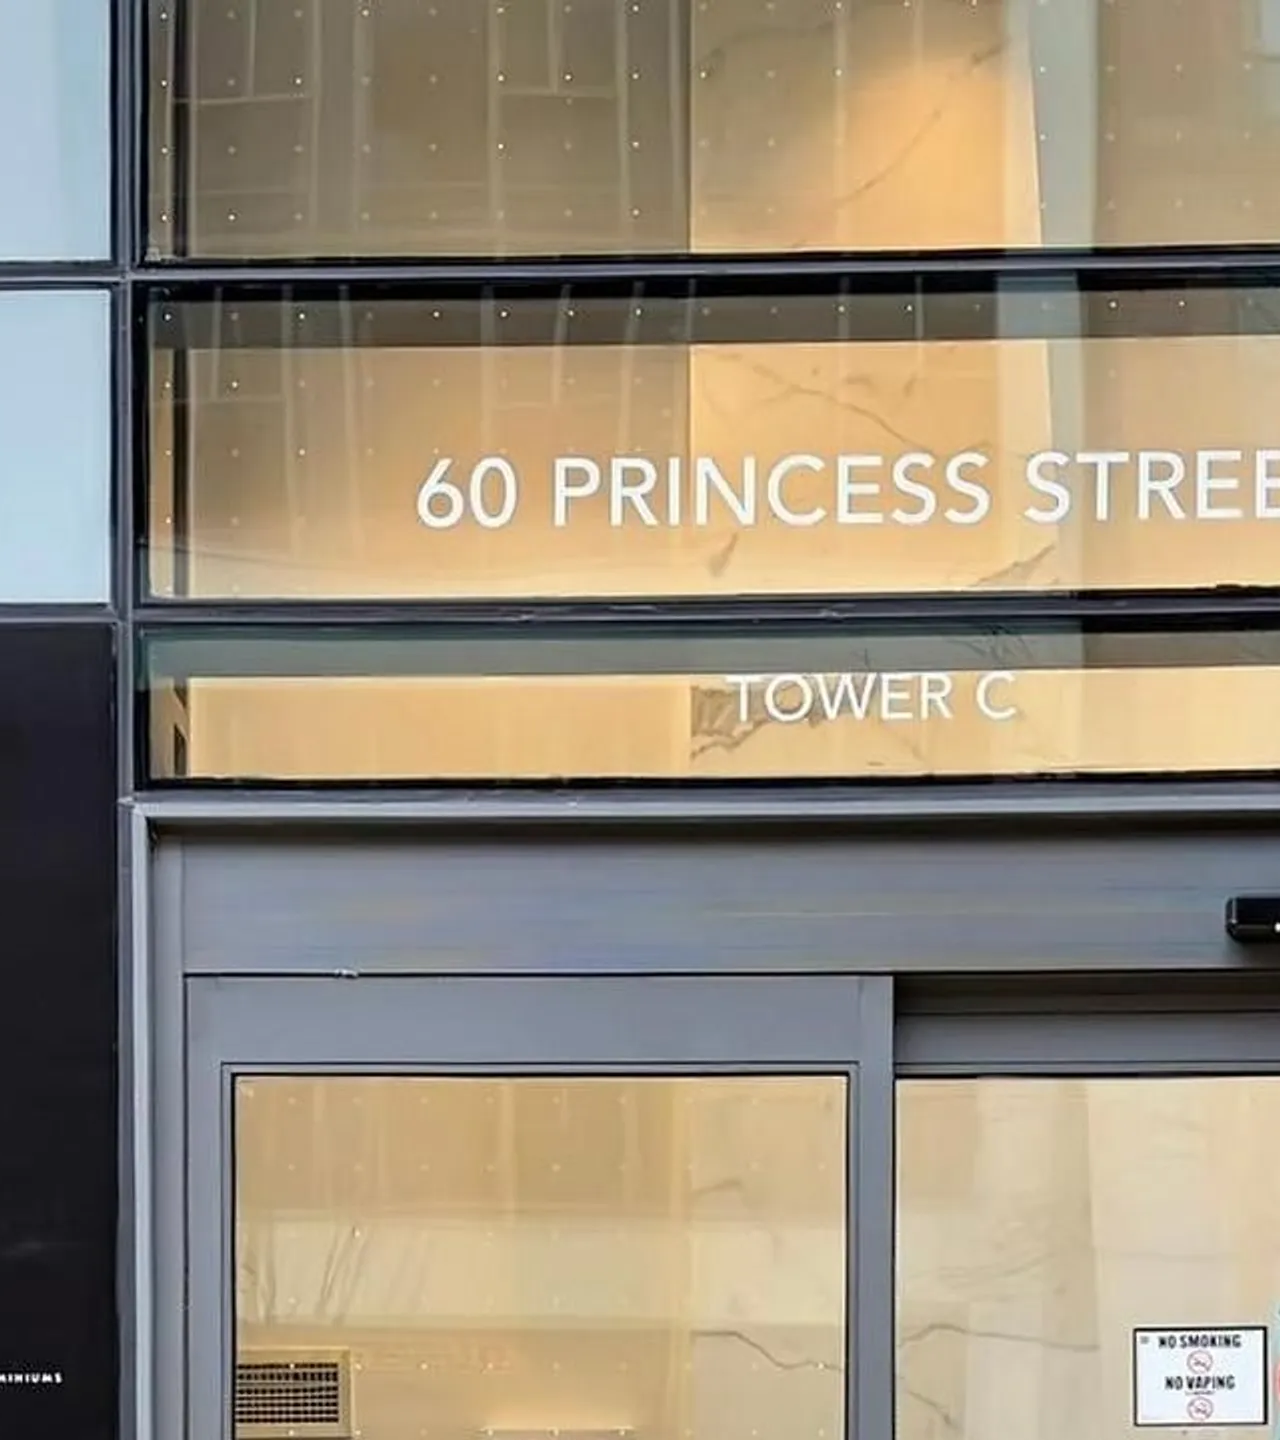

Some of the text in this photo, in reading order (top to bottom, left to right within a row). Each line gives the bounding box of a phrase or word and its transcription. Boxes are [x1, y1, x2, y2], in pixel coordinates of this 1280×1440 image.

[417, 456, 518, 529] 60
[553, 453, 991, 527] PRINCESS
[725, 671, 1017, 722] TOWER C
[1158, 1333, 1242, 1349] NO SMOKING
[1164, 1374, 1236, 1390] NO VAPING
